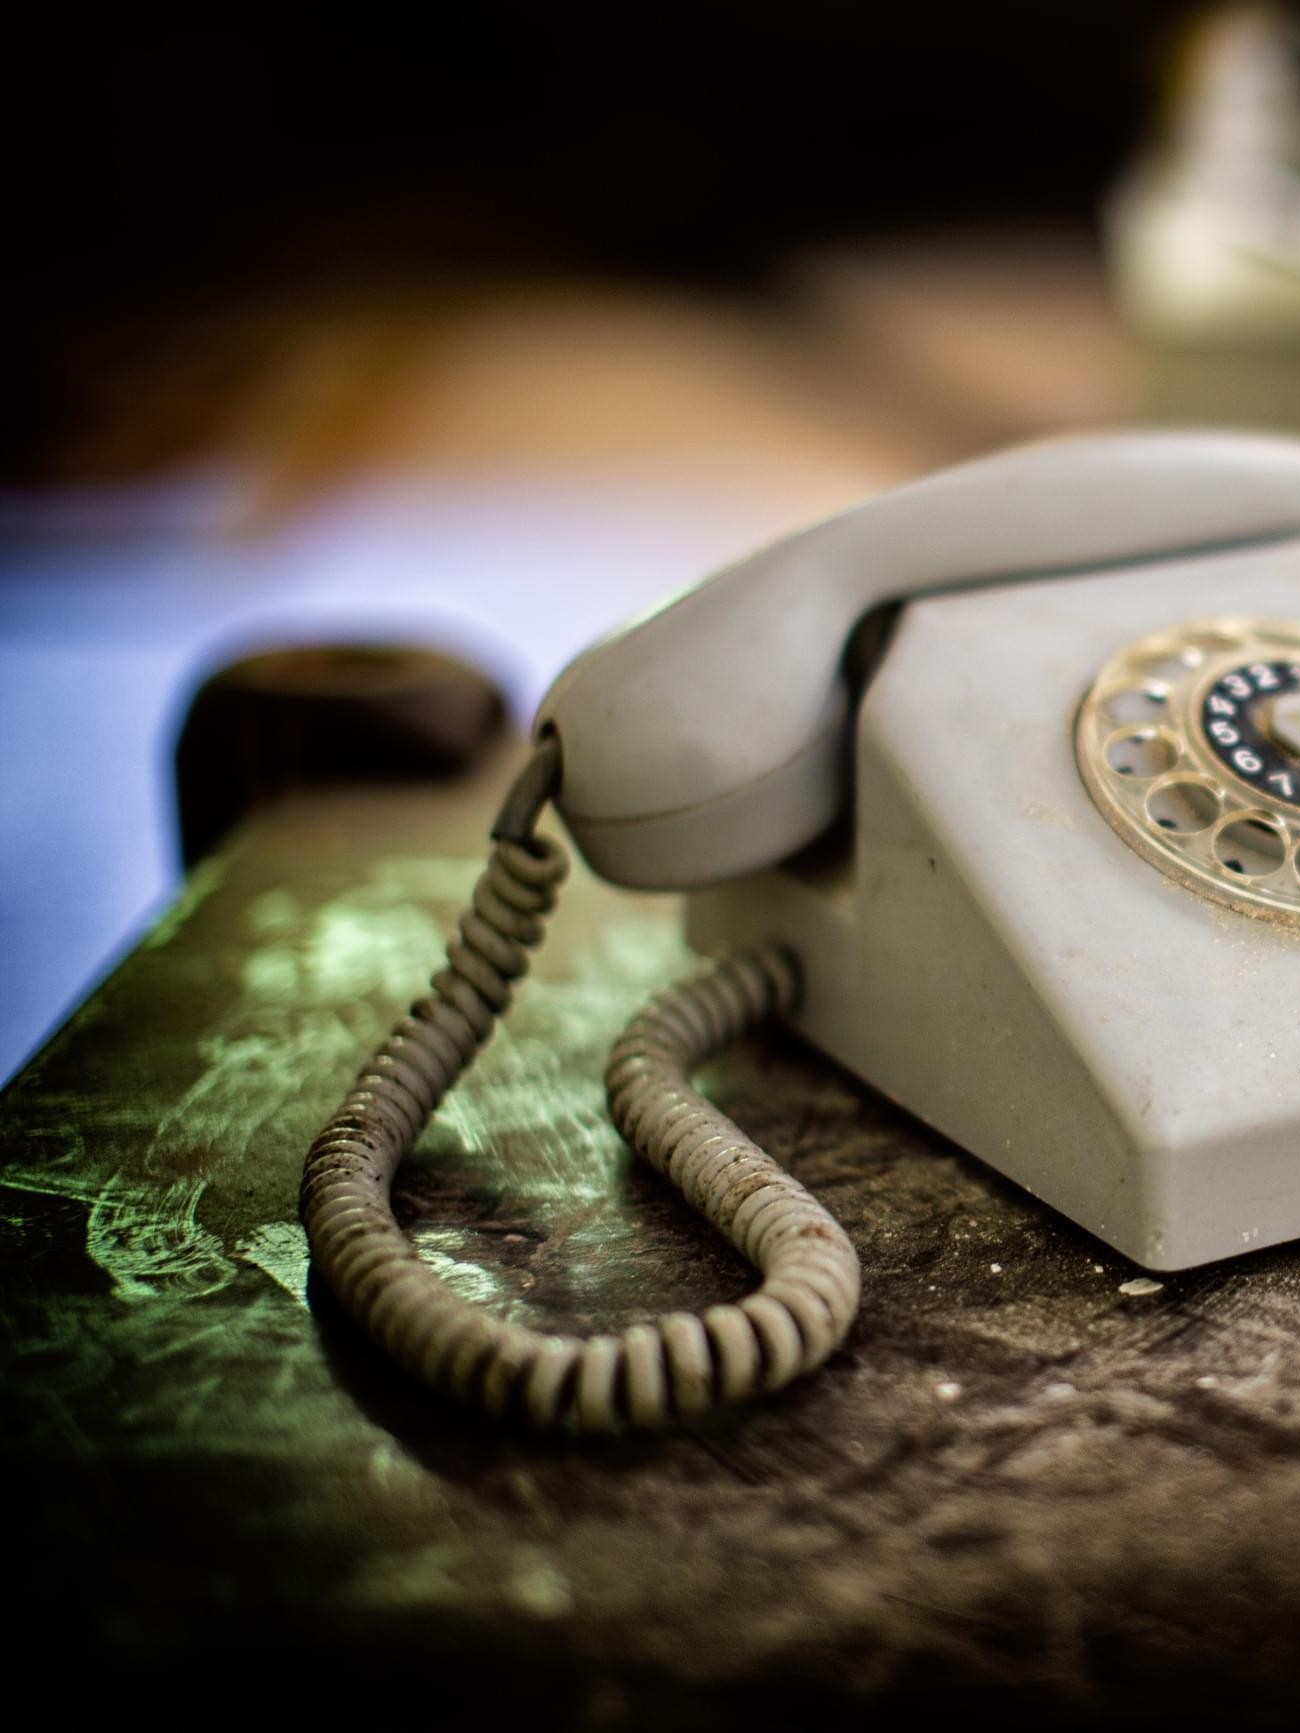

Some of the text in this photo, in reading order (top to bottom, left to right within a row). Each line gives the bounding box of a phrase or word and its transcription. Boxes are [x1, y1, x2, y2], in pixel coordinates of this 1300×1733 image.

[1223, 674, 1251, 697] 3
[1249, 664, 1280, 687] 2
[1208, 695, 1235, 716] 4
[1210, 721, 1239, 744] 5
[1233, 749, 1262, 772] 6
[1268, 772, 1293, 797] 7
